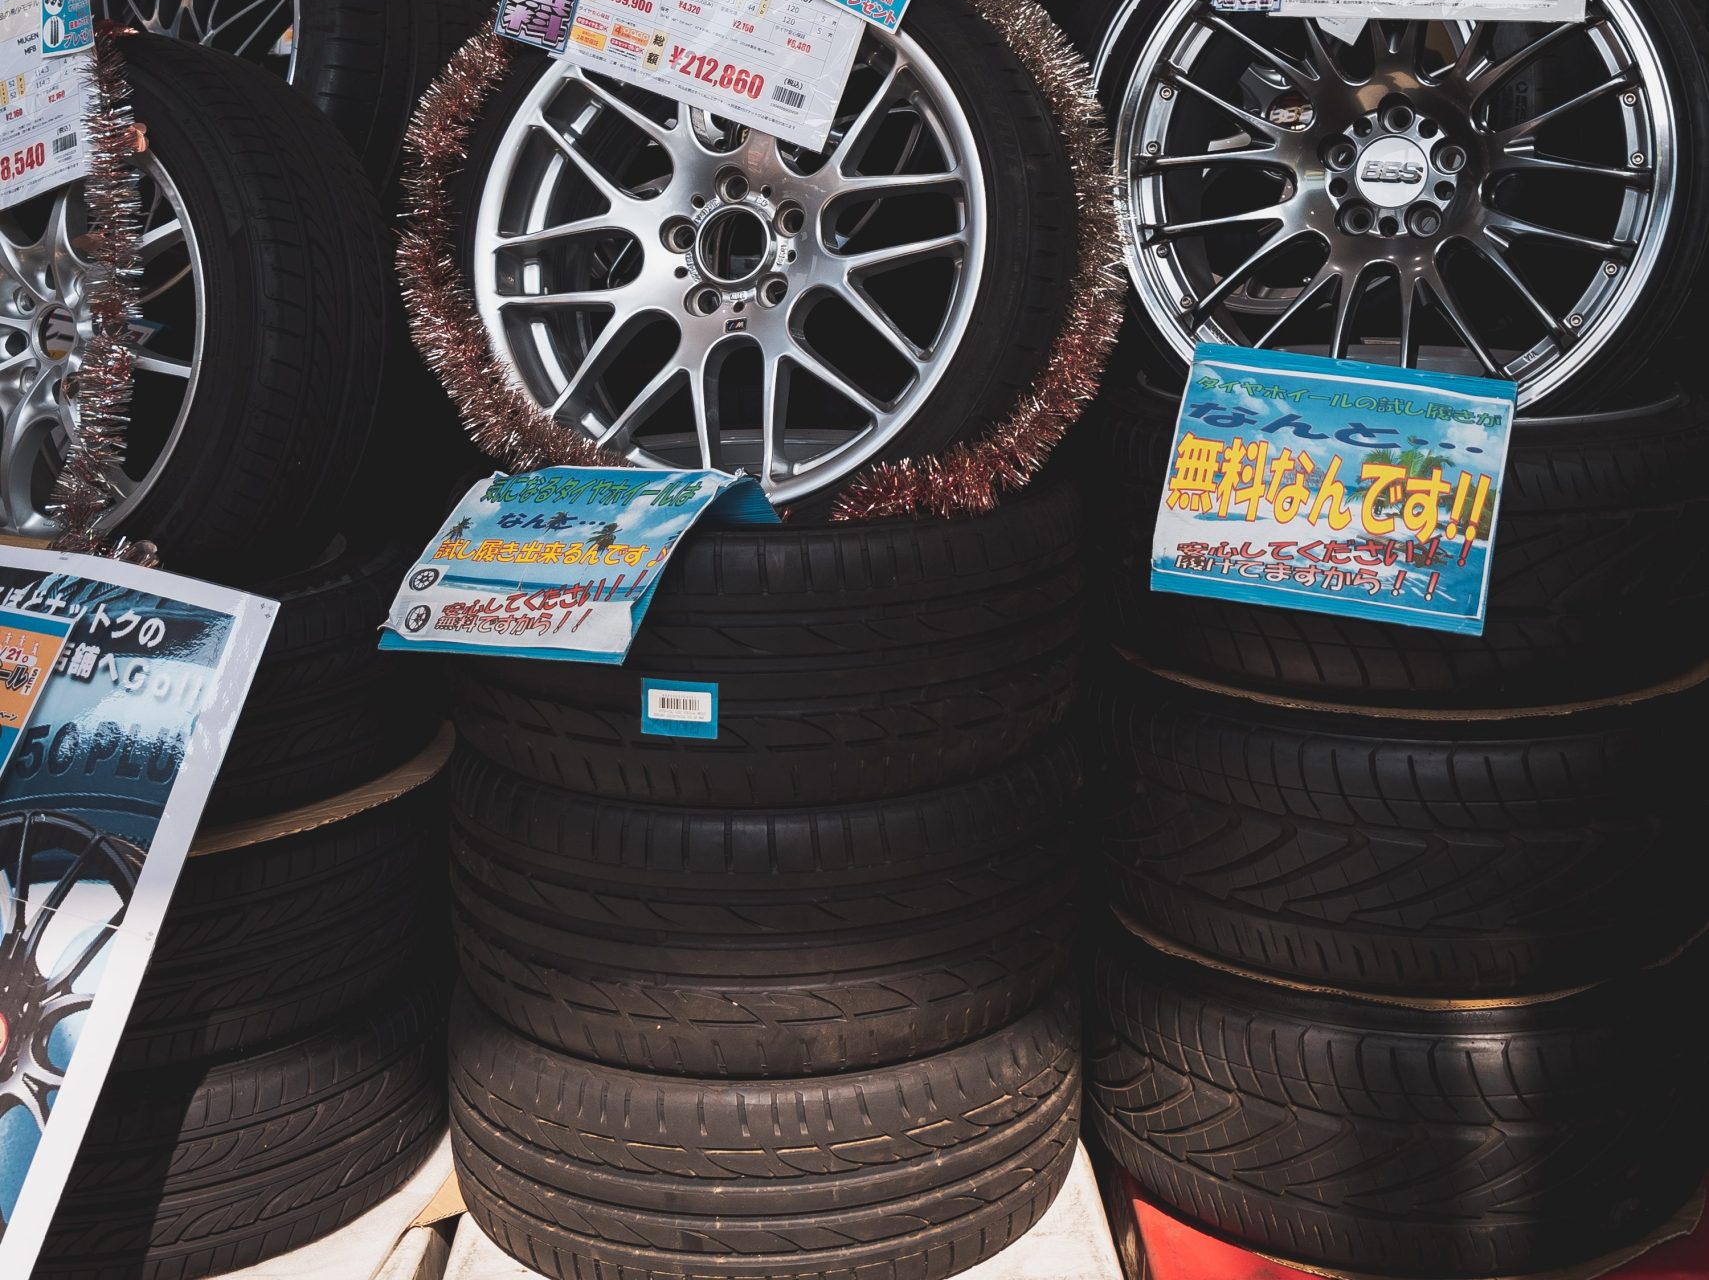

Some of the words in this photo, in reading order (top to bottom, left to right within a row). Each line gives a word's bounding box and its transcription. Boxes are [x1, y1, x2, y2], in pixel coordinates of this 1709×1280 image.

[676, 0, 702, 16] ¥4,320
[781, 15, 796, 26] 120
[785, 3, 800, 14] 120
[820, 15, 826, 23] 5
[17, 32, 39, 45] MUGEN
[646, 33, 666, 65] 総額
[785, 37, 812, 54] ¥6,480
[665, 43, 767, 101] ¥212,860
[782, 77, 804, 90] (税込)
[1360, 160, 1424, 184] BBS
[1196, 375, 1502, 427] タイヤホイールの試し履きが
[479, 475, 702, 508] 気になるタイヤホイールは
[1165, 430, 1493, 545] 無料なんです!!
[1176, 534, 1472, 568] 安心してください！！
[1174, 554, 1442, 601] 履けてますから！！
[0, 586, 166, 648] ほどナットクの
[434, 608, 593, 637] 無料ですから！！
[24, 669, 37, 693] SET
